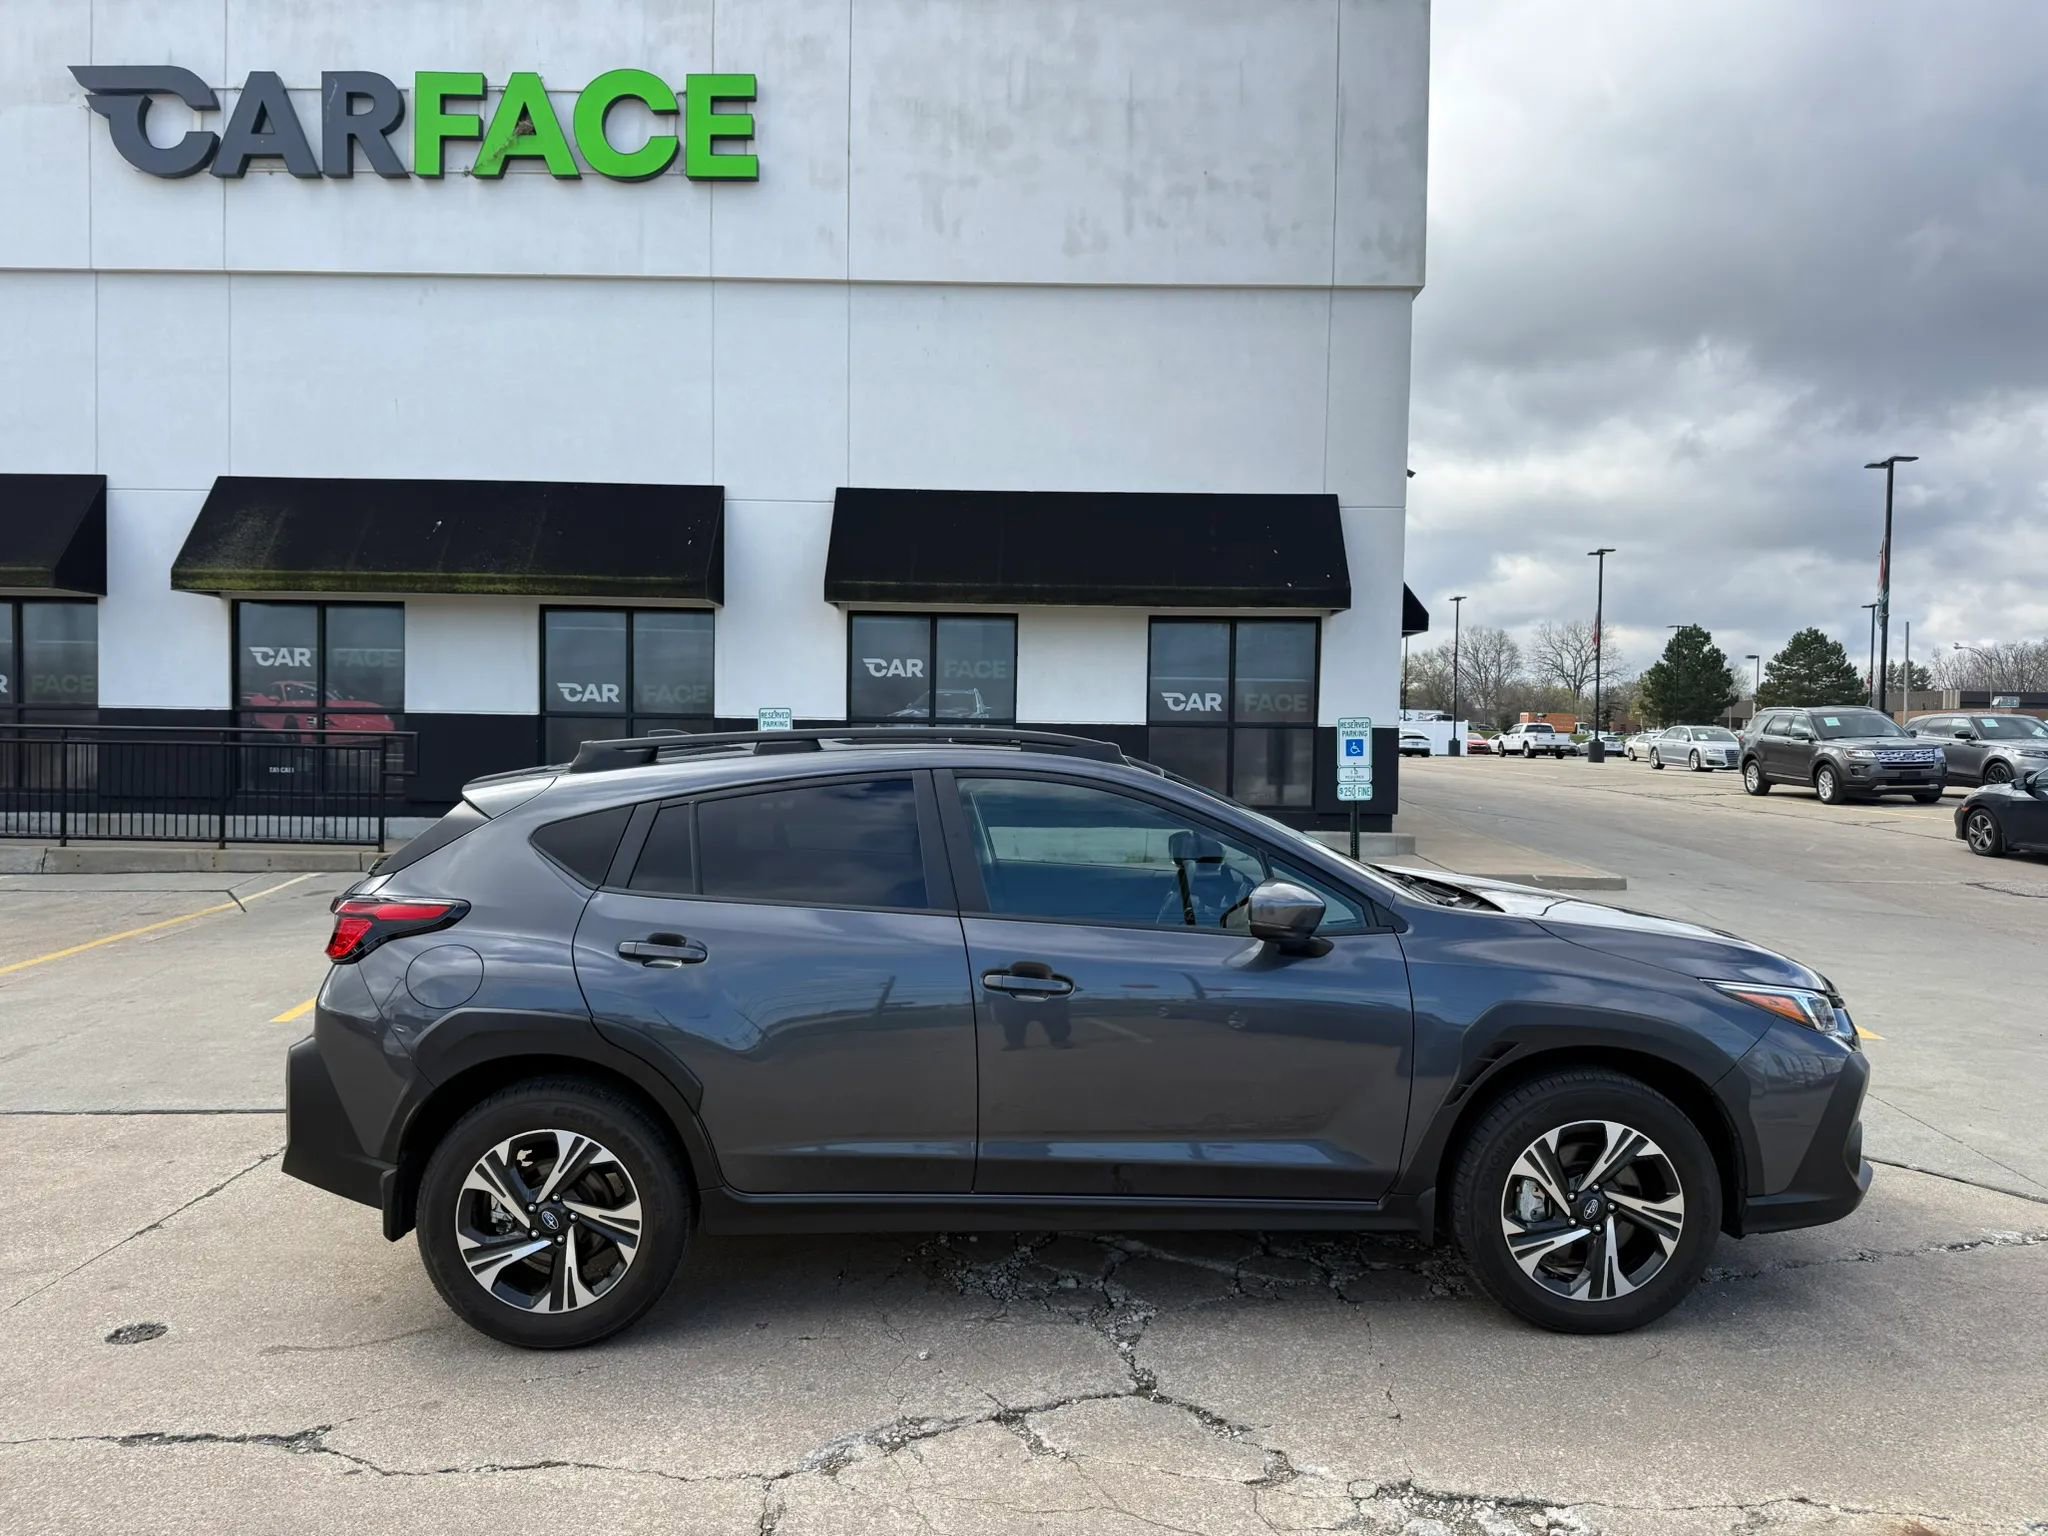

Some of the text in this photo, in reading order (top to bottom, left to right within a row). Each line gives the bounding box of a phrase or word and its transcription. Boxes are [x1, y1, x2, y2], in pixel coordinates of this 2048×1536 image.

[249, 647, 398, 668] CAR FACE
[862, 658, 1008, 679] CAR FACE
[32, 674, 95, 693] FACE
[557, 682, 708, 704] CAR FACE
[1161, 692, 1309, 713] CAR FACE
[761, 711, 789, 719] RESERVED
[763, 720, 788, 728] PARKING
[1340, 721, 1369, 729] RESERVED
[1338, 786, 1371, 797] $250 FINE
